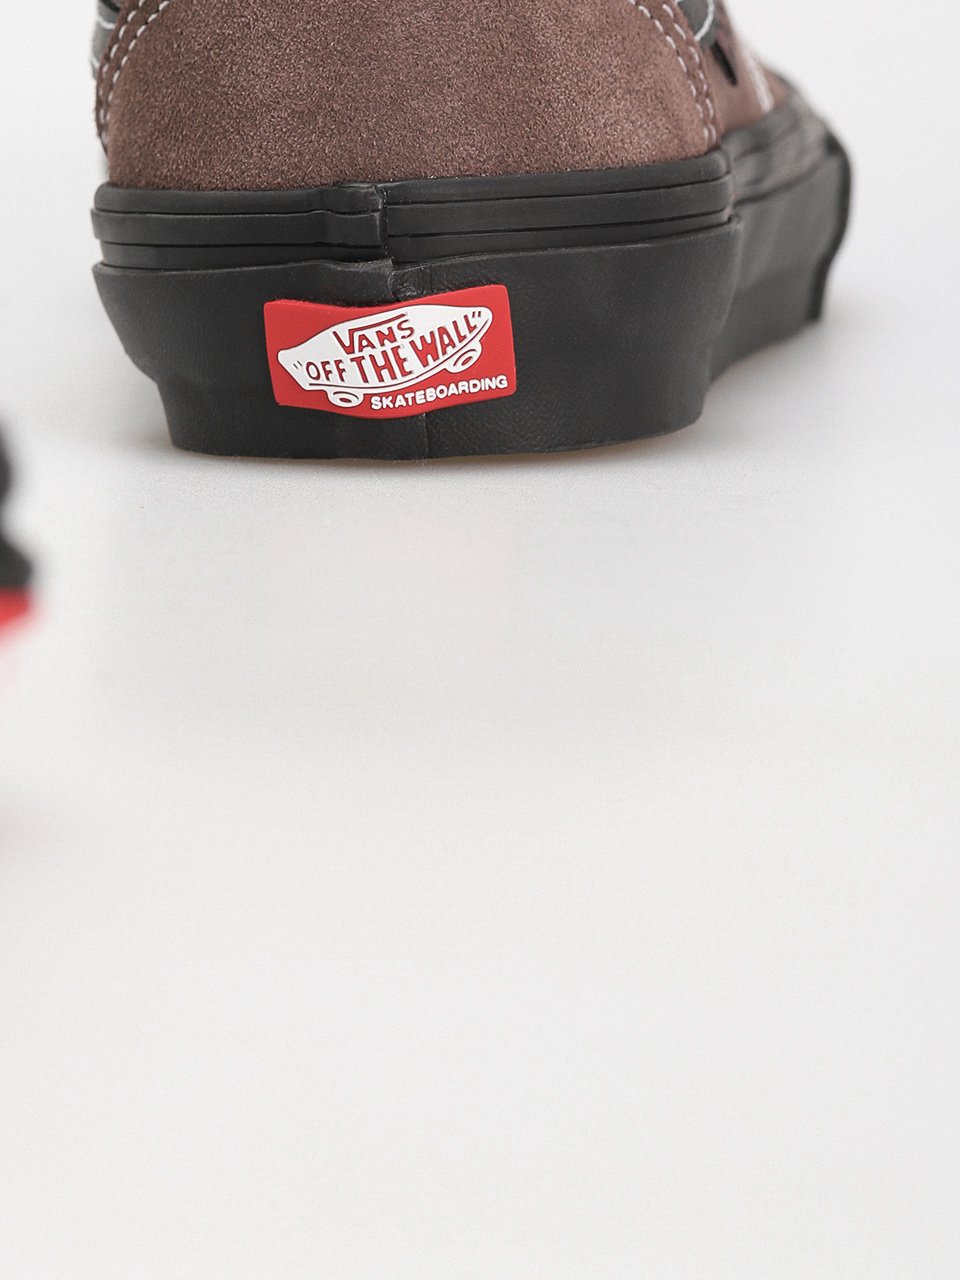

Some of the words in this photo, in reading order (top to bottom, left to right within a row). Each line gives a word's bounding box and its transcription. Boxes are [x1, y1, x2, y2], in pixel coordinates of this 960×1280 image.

[331, 311, 415, 356] VANS
[349, 345, 414, 384] THE
[371, 374, 508, 410] SKATEBOARDING
